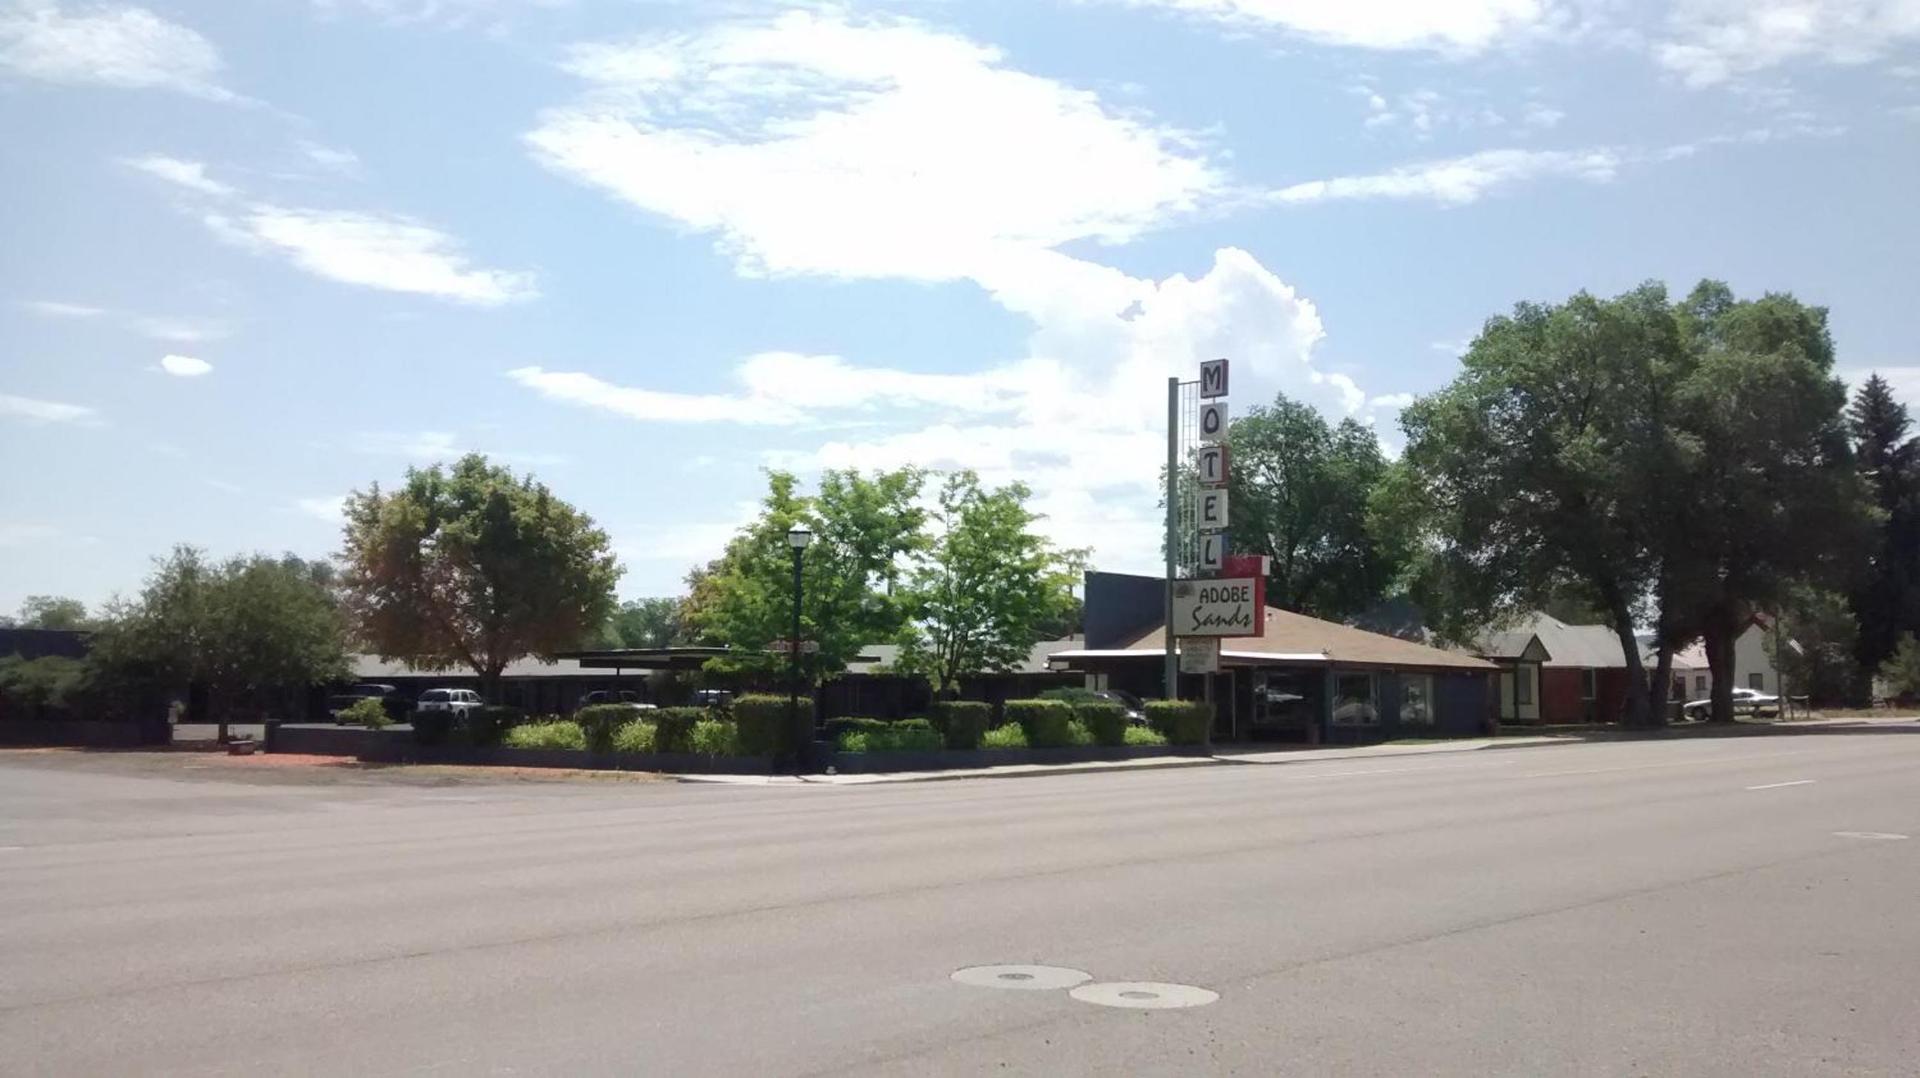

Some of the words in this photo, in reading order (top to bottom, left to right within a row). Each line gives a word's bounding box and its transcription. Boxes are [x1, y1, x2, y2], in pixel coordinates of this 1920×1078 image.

[1203, 365, 1222, 566] MOTEL
[1199, 586, 1250, 604] ADOBE
[1191, 604, 1251, 632] Sands
